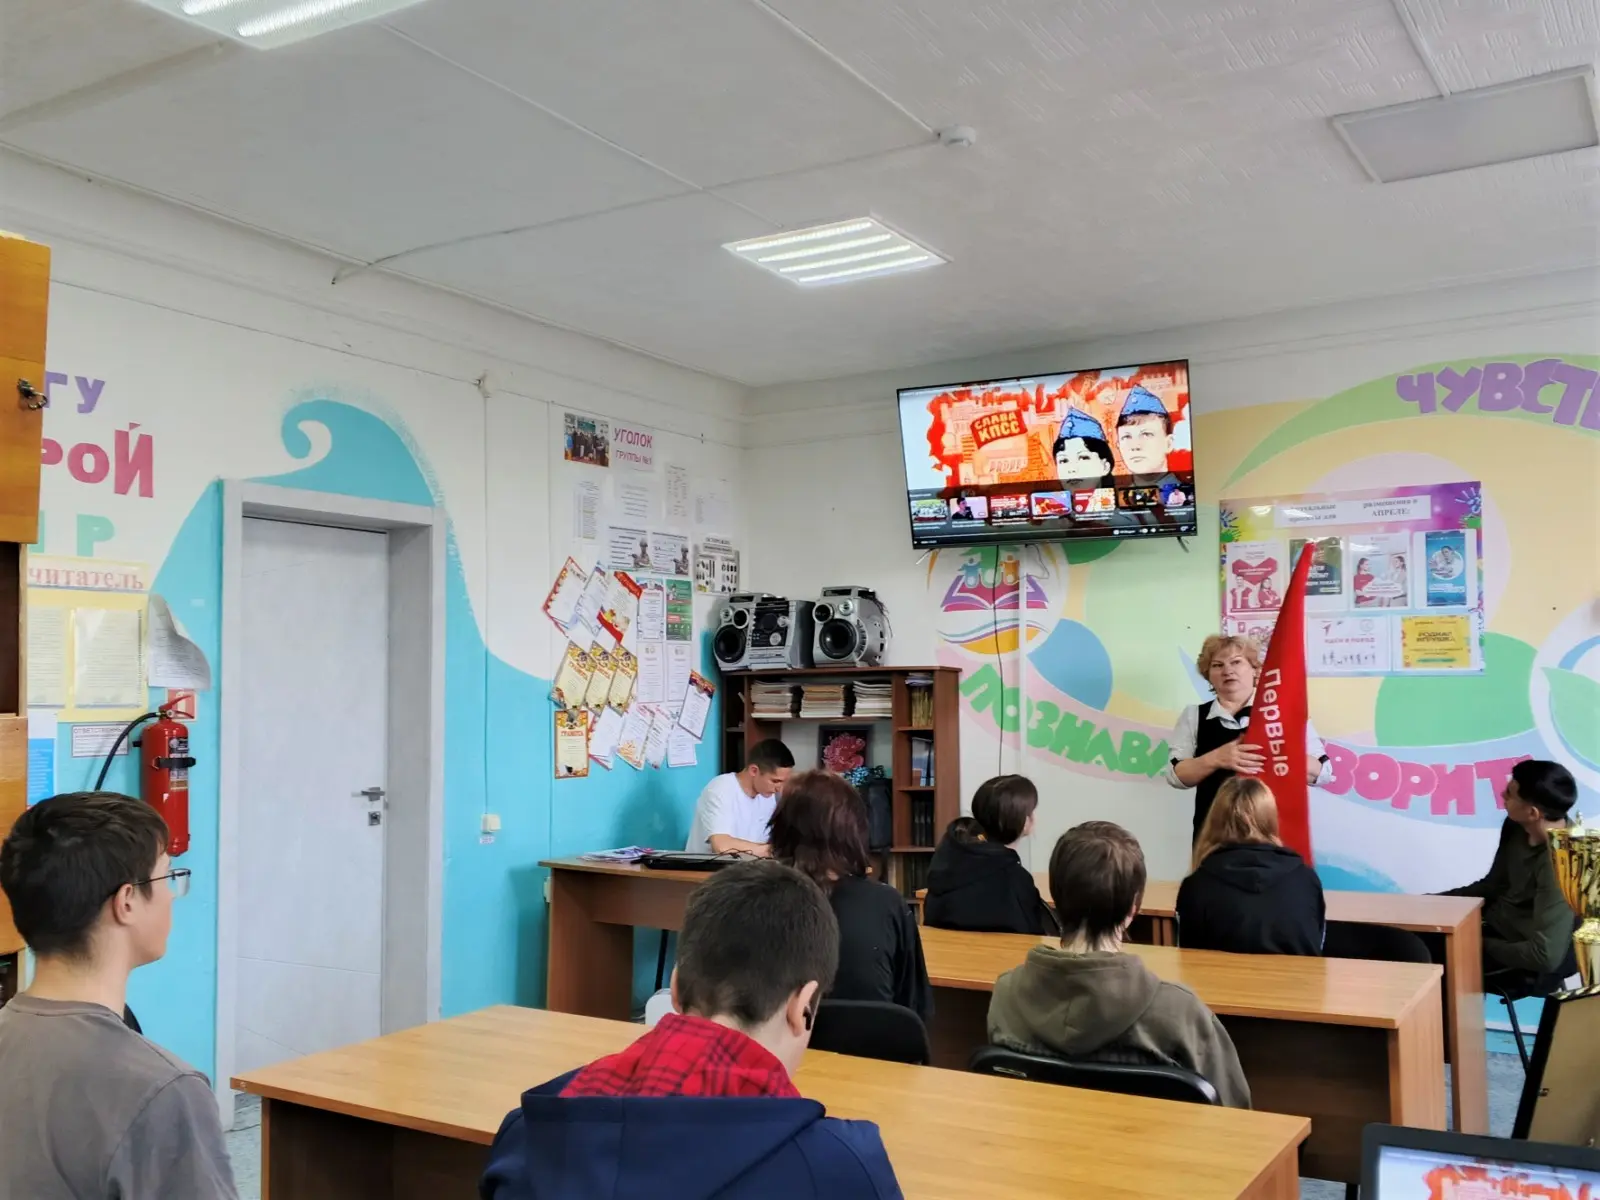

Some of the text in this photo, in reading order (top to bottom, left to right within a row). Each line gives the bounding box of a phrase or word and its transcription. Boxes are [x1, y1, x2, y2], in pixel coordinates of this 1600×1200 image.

[44, 371, 106, 414] ГУ
[974, 412, 1017, 430] СЛАВА
[978, 421, 1020, 442] КПСС
[614, 427, 652, 448] УГОЛОК
[41, 422, 154, 498] РОЙ
[29, 568, 144, 590] читатель
[959, 663, 1170, 778] ПОЗНАВА
[1322, 743, 1534, 816] ВОРИТ
